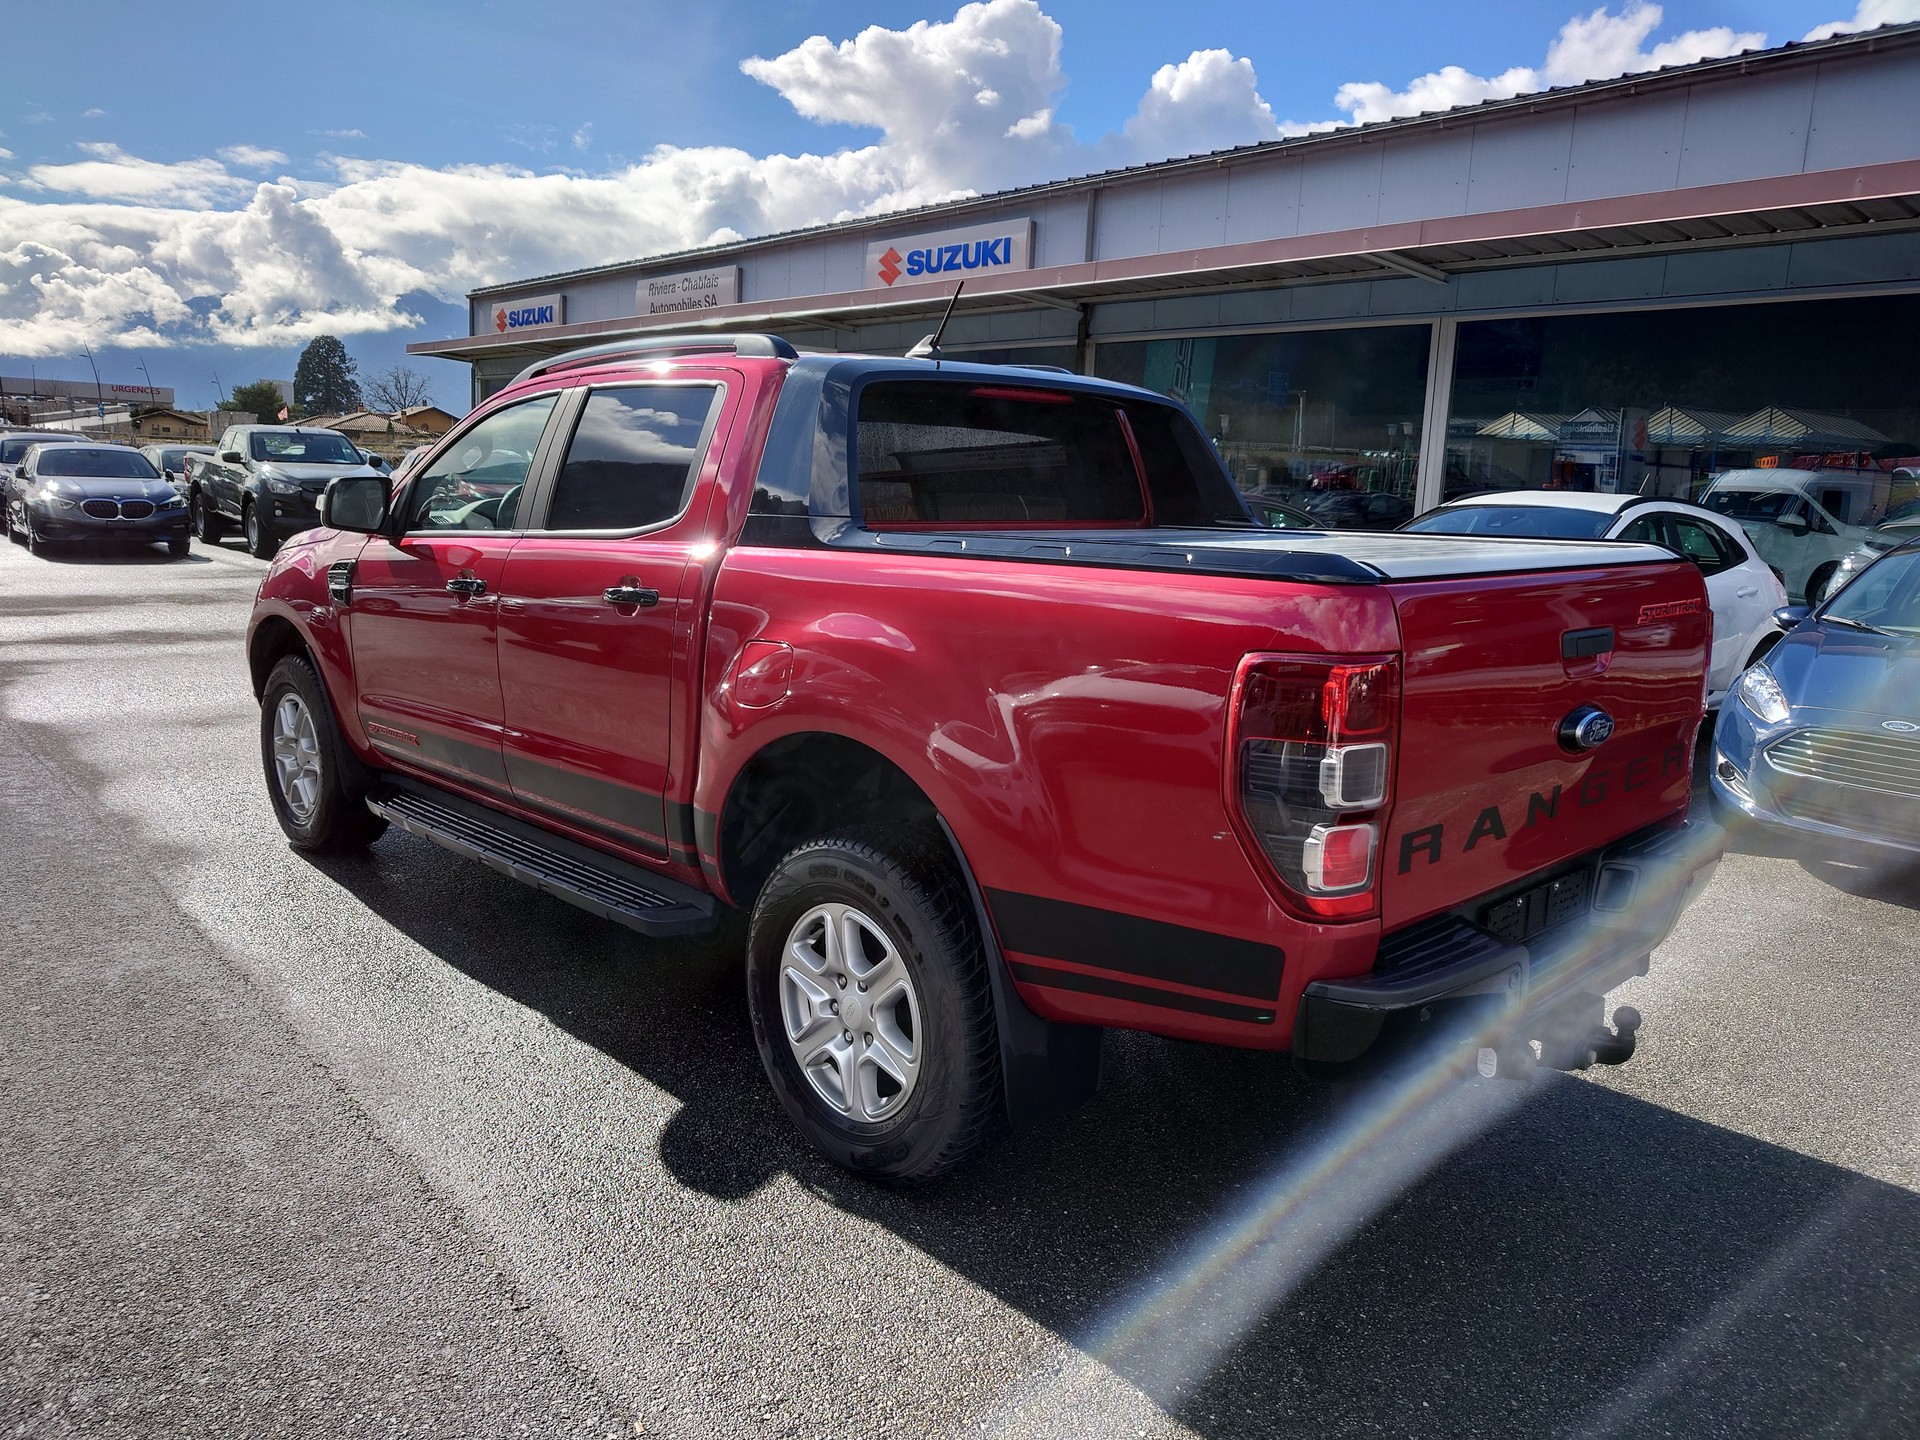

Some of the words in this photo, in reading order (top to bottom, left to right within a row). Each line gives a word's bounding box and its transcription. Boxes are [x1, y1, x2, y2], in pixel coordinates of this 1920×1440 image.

[906, 237, 1011, 276] SUZUKI
[648, 281, 676, 296] Riviera
[681, 274, 719, 292] Chablais
[649, 297, 703, 315] Automobiles
[704, 294, 718, 308] SA
[508, 305, 553, 328] SUZUKI
[111, 384, 161, 395] URGENCES
[1398, 744, 1684, 876] RANGER
